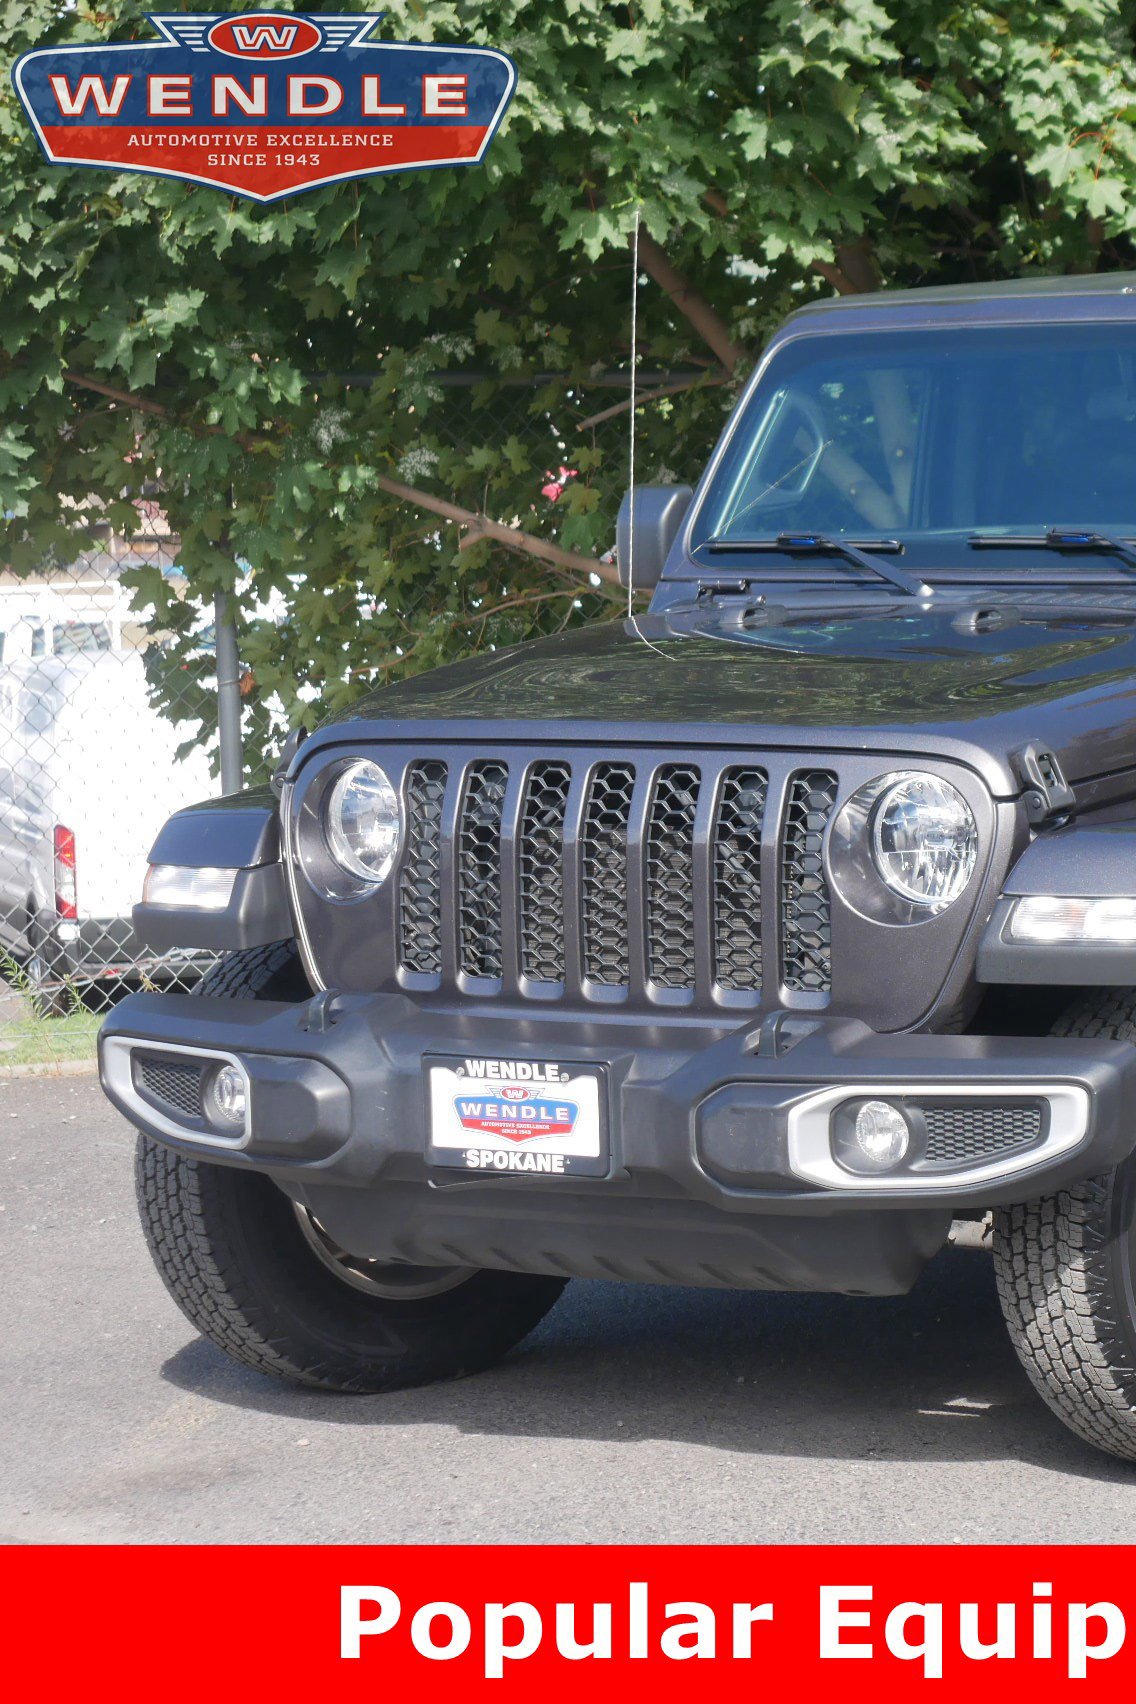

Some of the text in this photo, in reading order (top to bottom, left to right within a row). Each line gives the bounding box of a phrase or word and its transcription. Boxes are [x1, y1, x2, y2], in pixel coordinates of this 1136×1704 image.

[464, 1059, 559, 1082] WENDLE
[461, 1103, 569, 1121] WENDLE
[466, 1150, 565, 1173] SPOKANE
